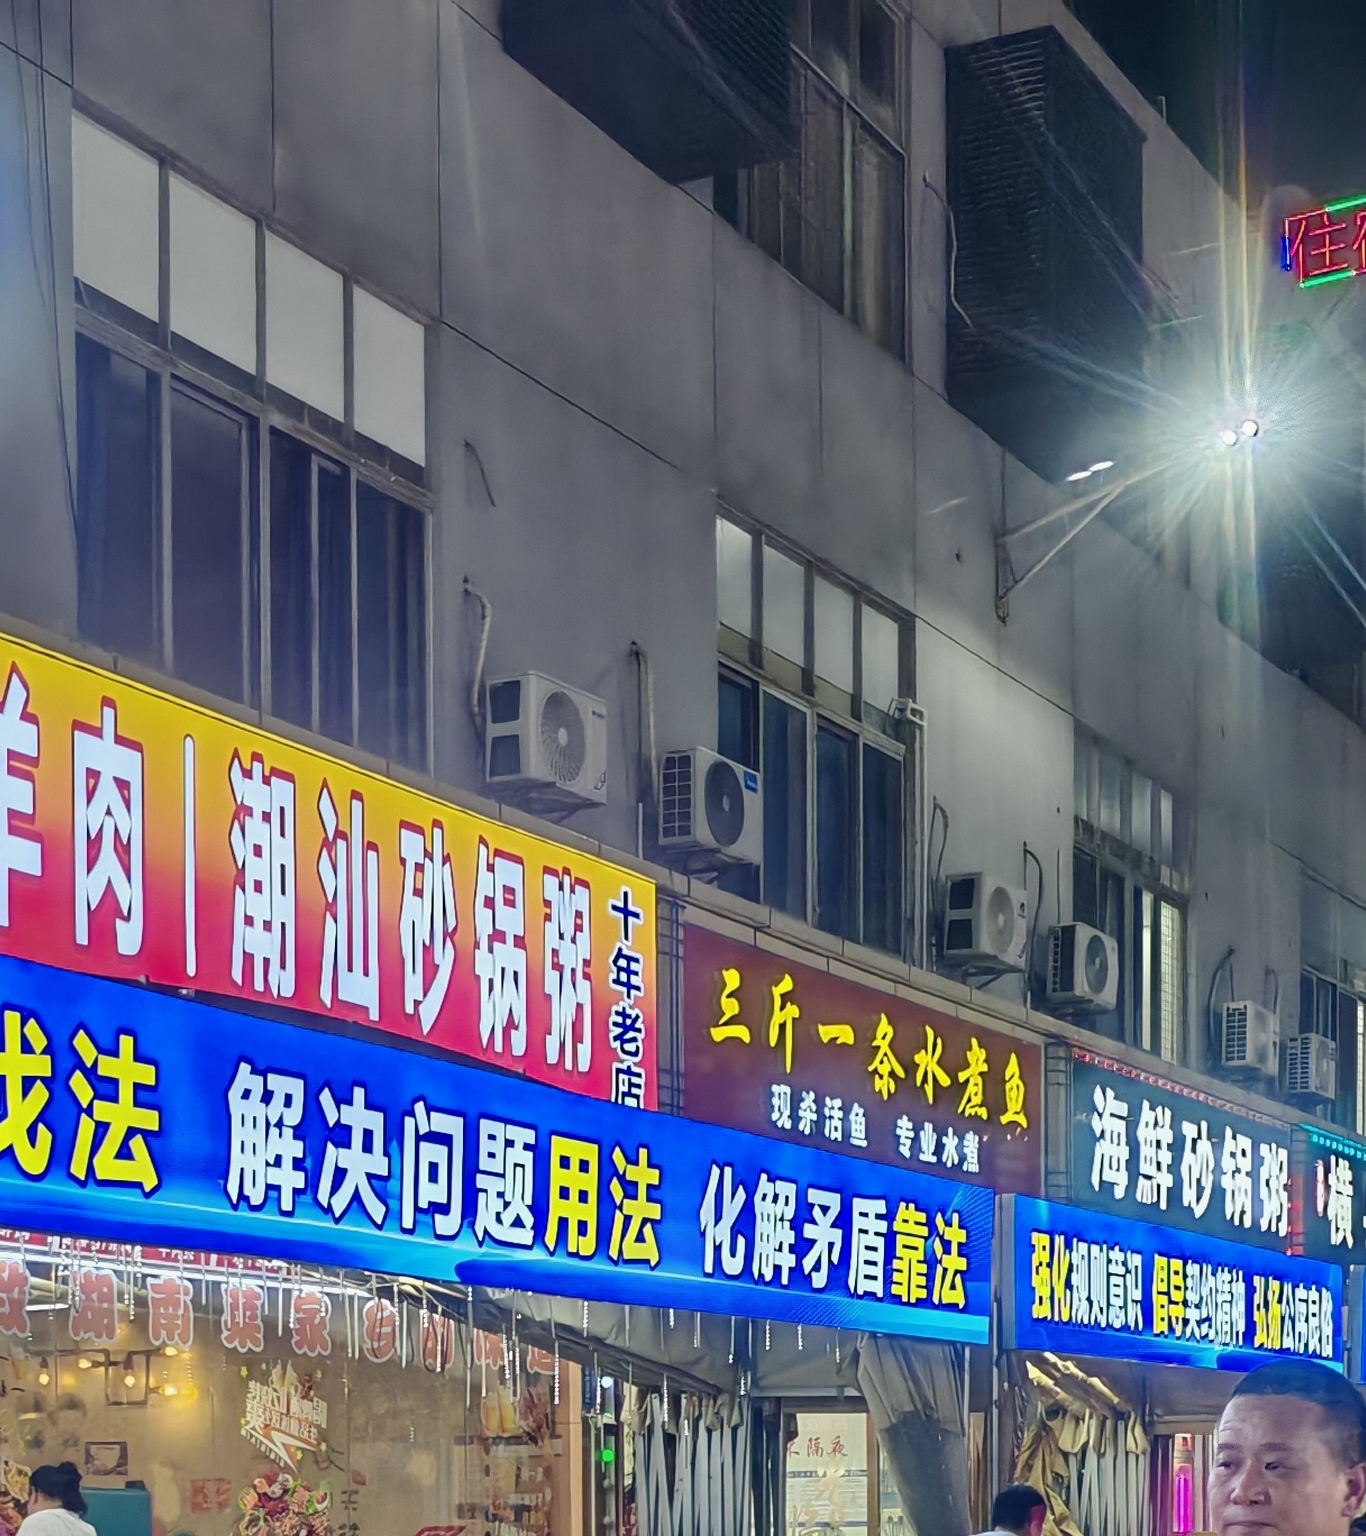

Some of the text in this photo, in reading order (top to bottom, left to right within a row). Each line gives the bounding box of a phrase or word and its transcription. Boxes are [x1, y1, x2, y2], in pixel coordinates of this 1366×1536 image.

[229, 752, 592, 1074] 潮汕砂锅粥
[608, 887, 645, 1111] 十年老店
[710, 968, 1029, 1130] 三斤一条水煮鱼
[225, 1061, 661, 1268] 解决问题用法
[700, 1164, 967, 1310] 化解矛盾靠法
[771, 1083, 980, 1172] 现杀活鱼 专业水煮
[1091, 1083, 1291, 1238] 海鲜砂锅粥
[1031, 1231, 1144, 1332] 强化规则意识
